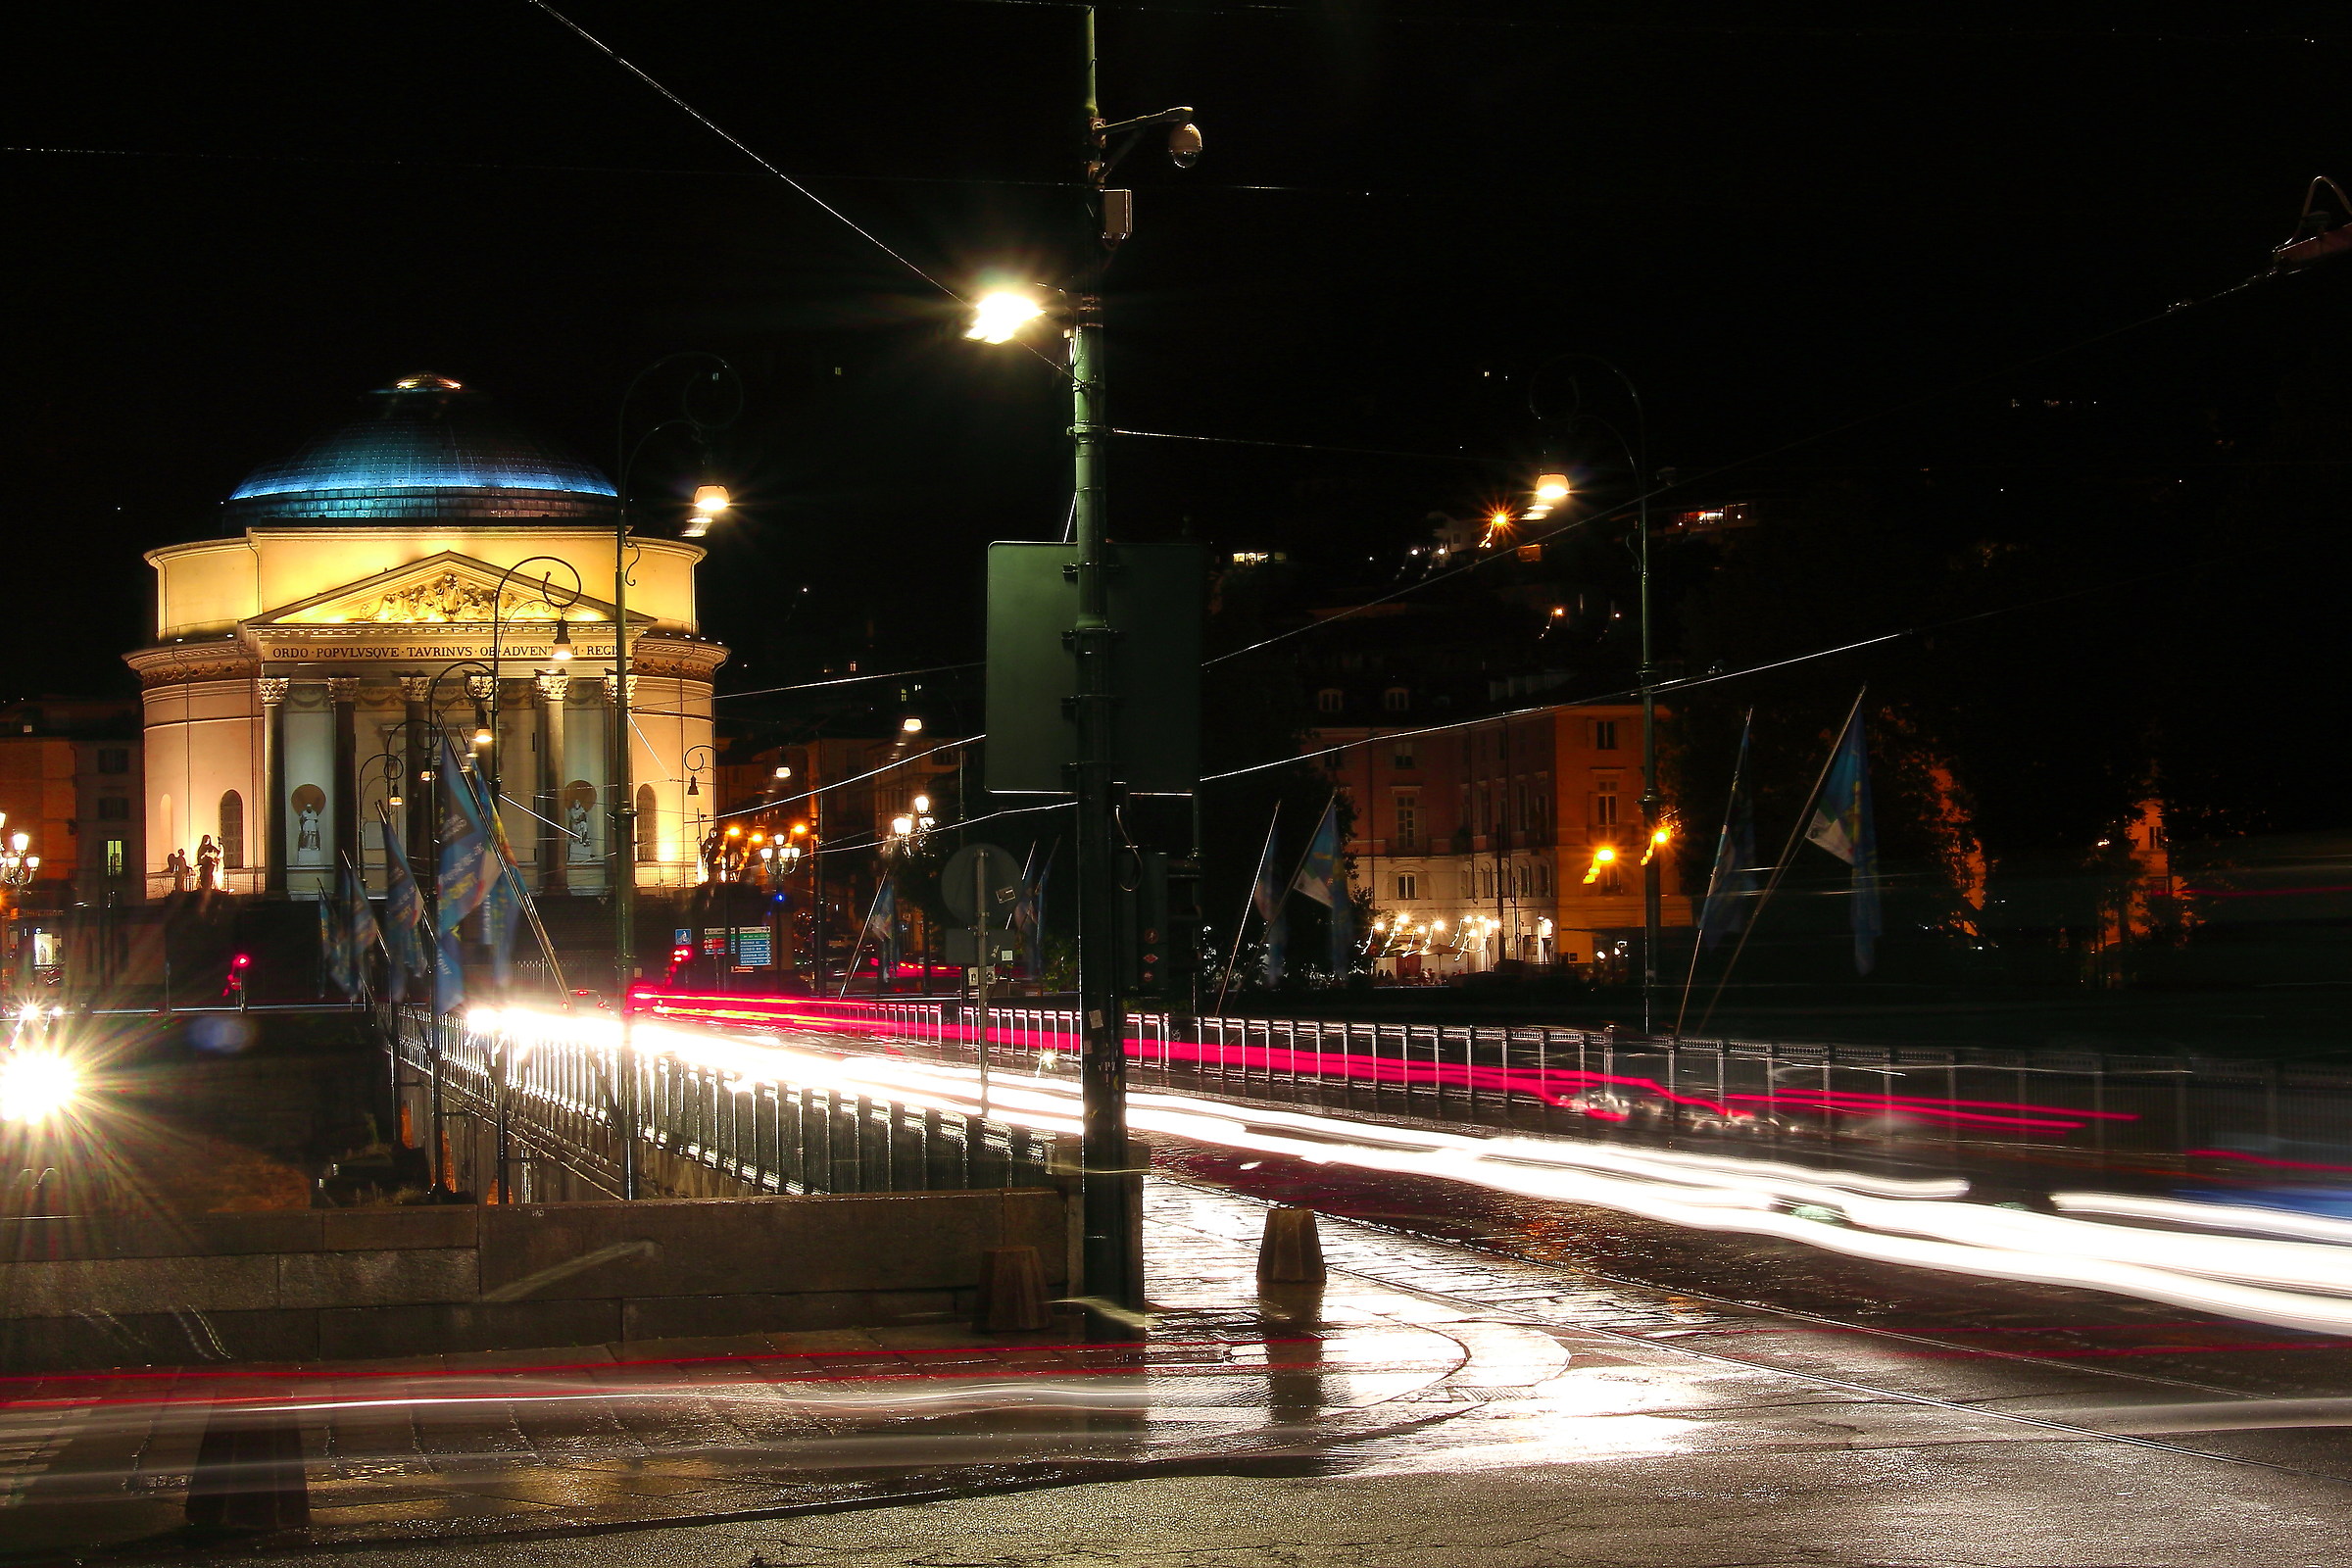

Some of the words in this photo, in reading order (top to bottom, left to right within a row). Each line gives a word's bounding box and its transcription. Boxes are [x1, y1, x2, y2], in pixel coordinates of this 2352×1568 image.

[272, 648, 309, 658] ORDO
[317, 647, 399, 659] POPVLVSQVE
[407, 647, 472, 657] TAVRINVS
[587, 645, 616, 656] REGI
